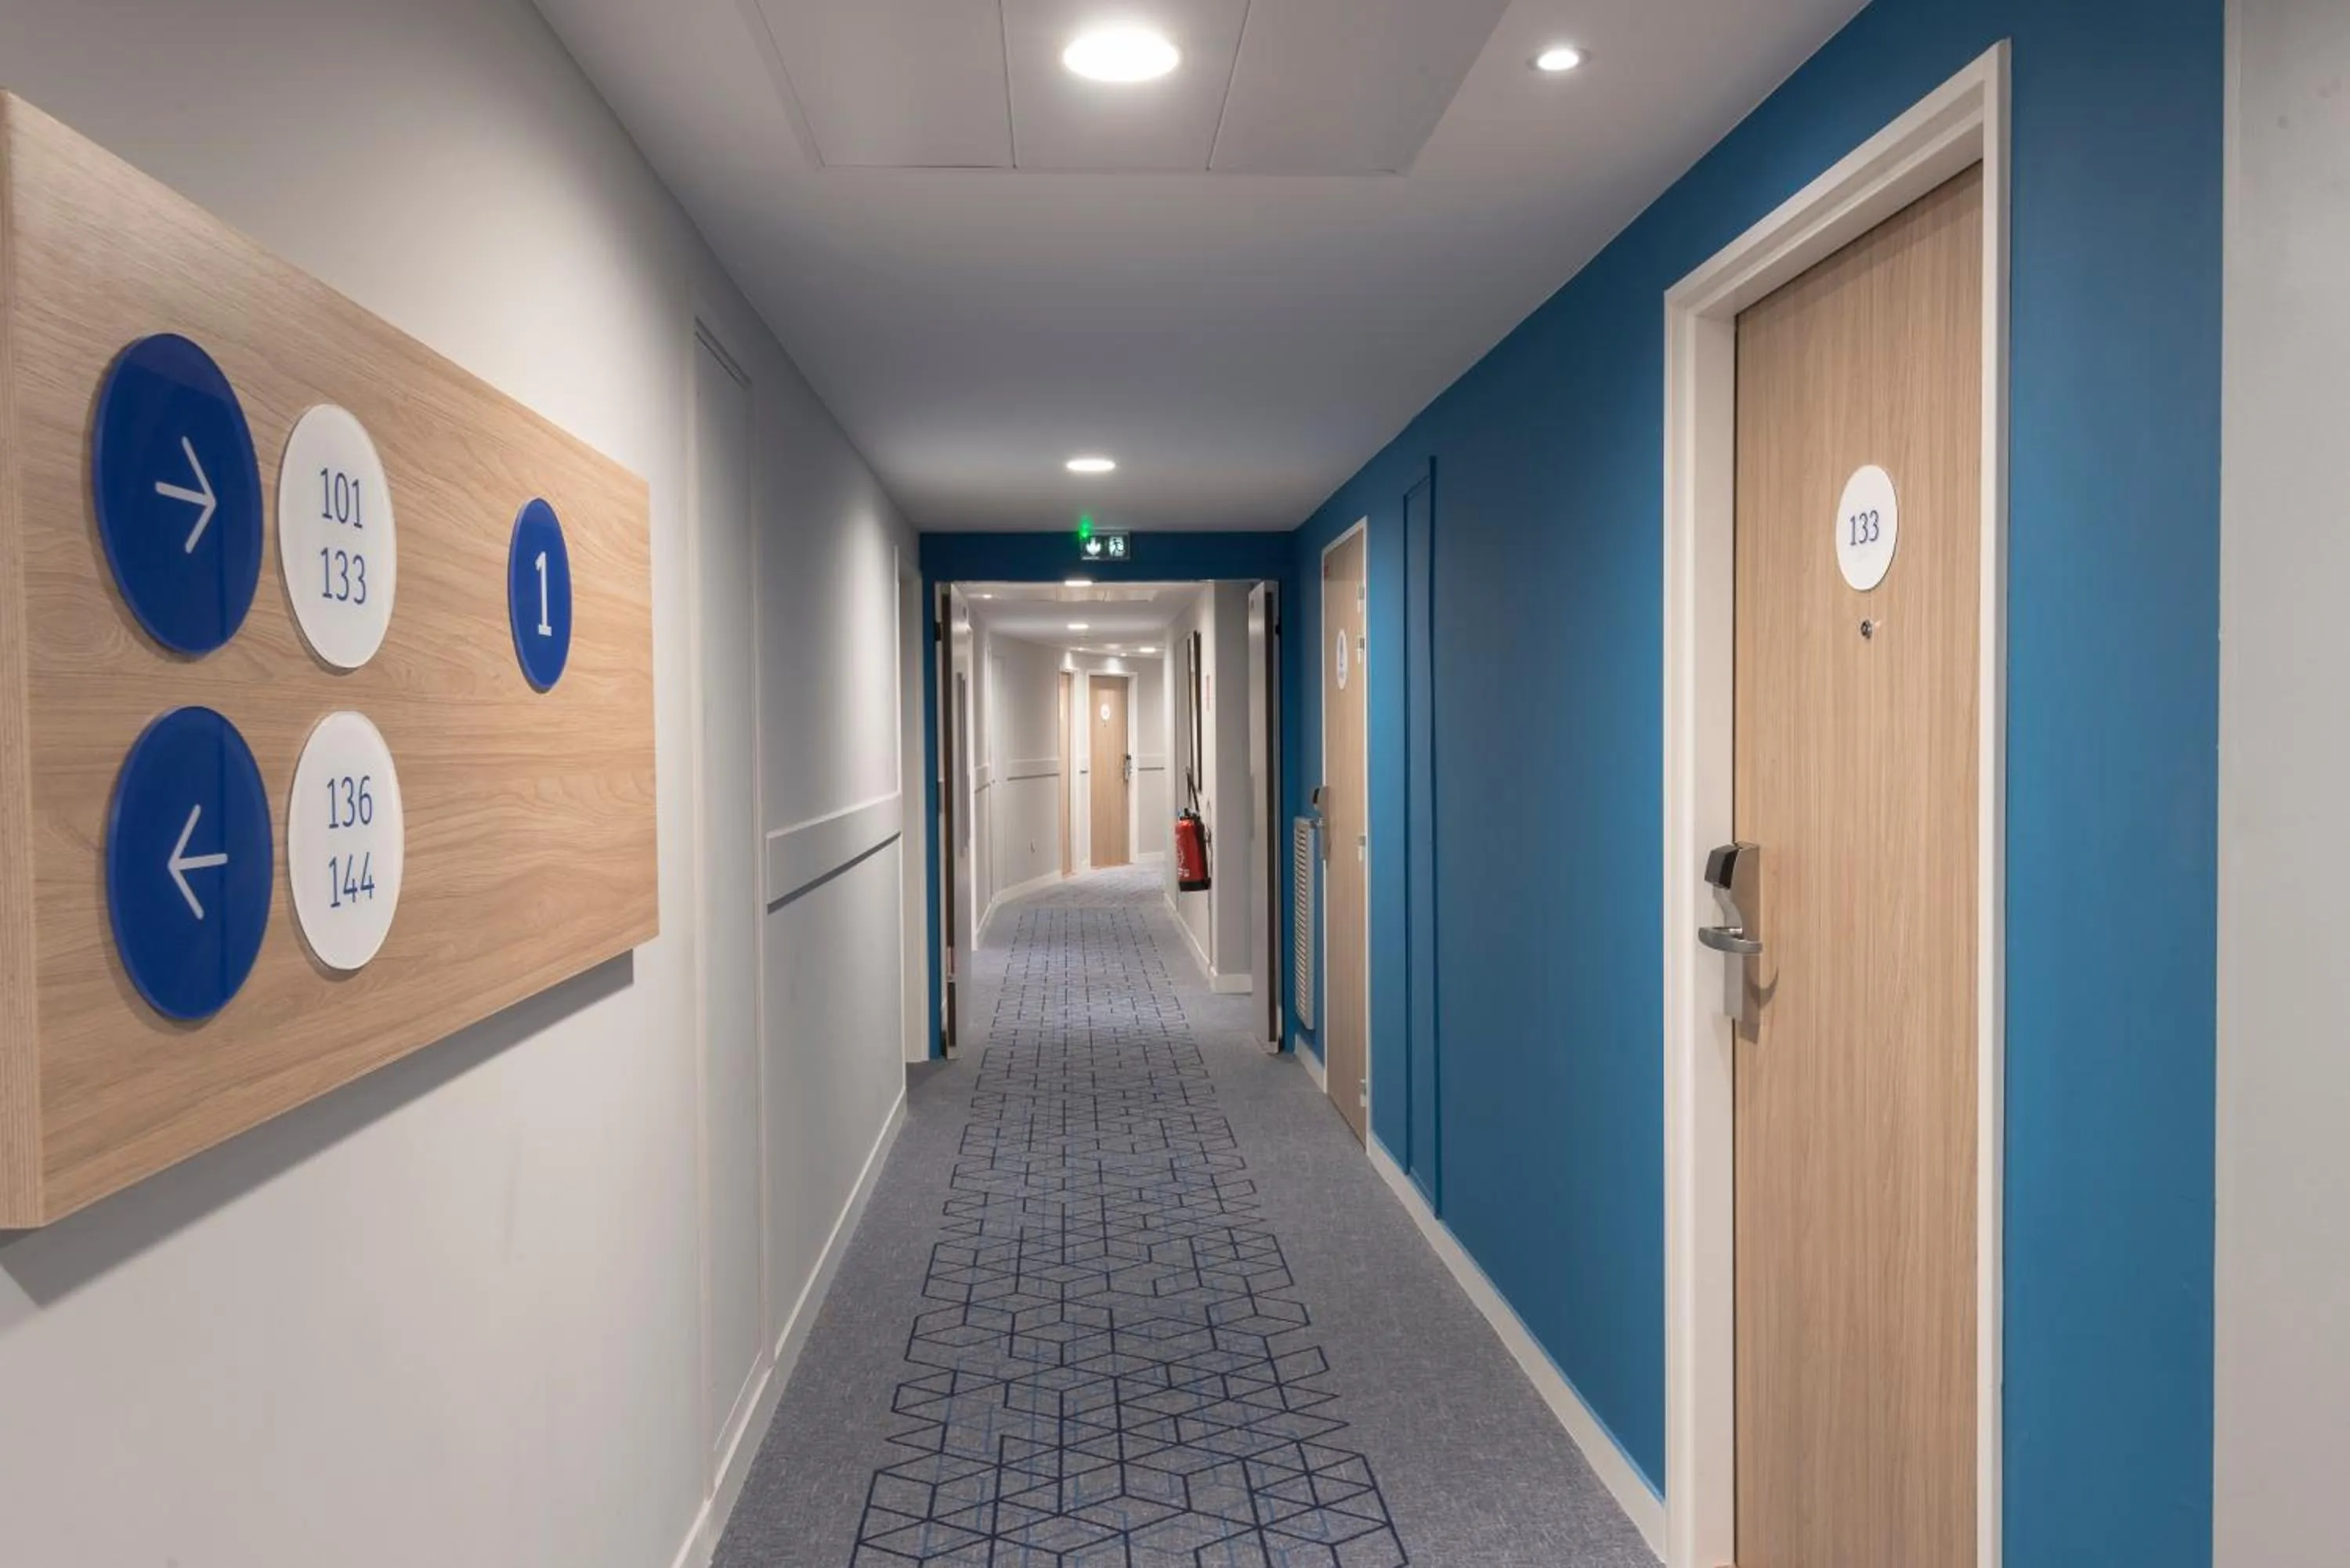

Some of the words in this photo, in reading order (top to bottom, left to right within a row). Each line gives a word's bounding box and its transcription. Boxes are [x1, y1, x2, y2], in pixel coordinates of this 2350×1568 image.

[320, 468, 363, 529] 101
[1849, 510, 1879, 546] 133
[320, 547, 367, 605] 133
[535, 551, 552, 636] 1
[327, 775, 373, 829] 136
[328, 851, 375, 909] 144
